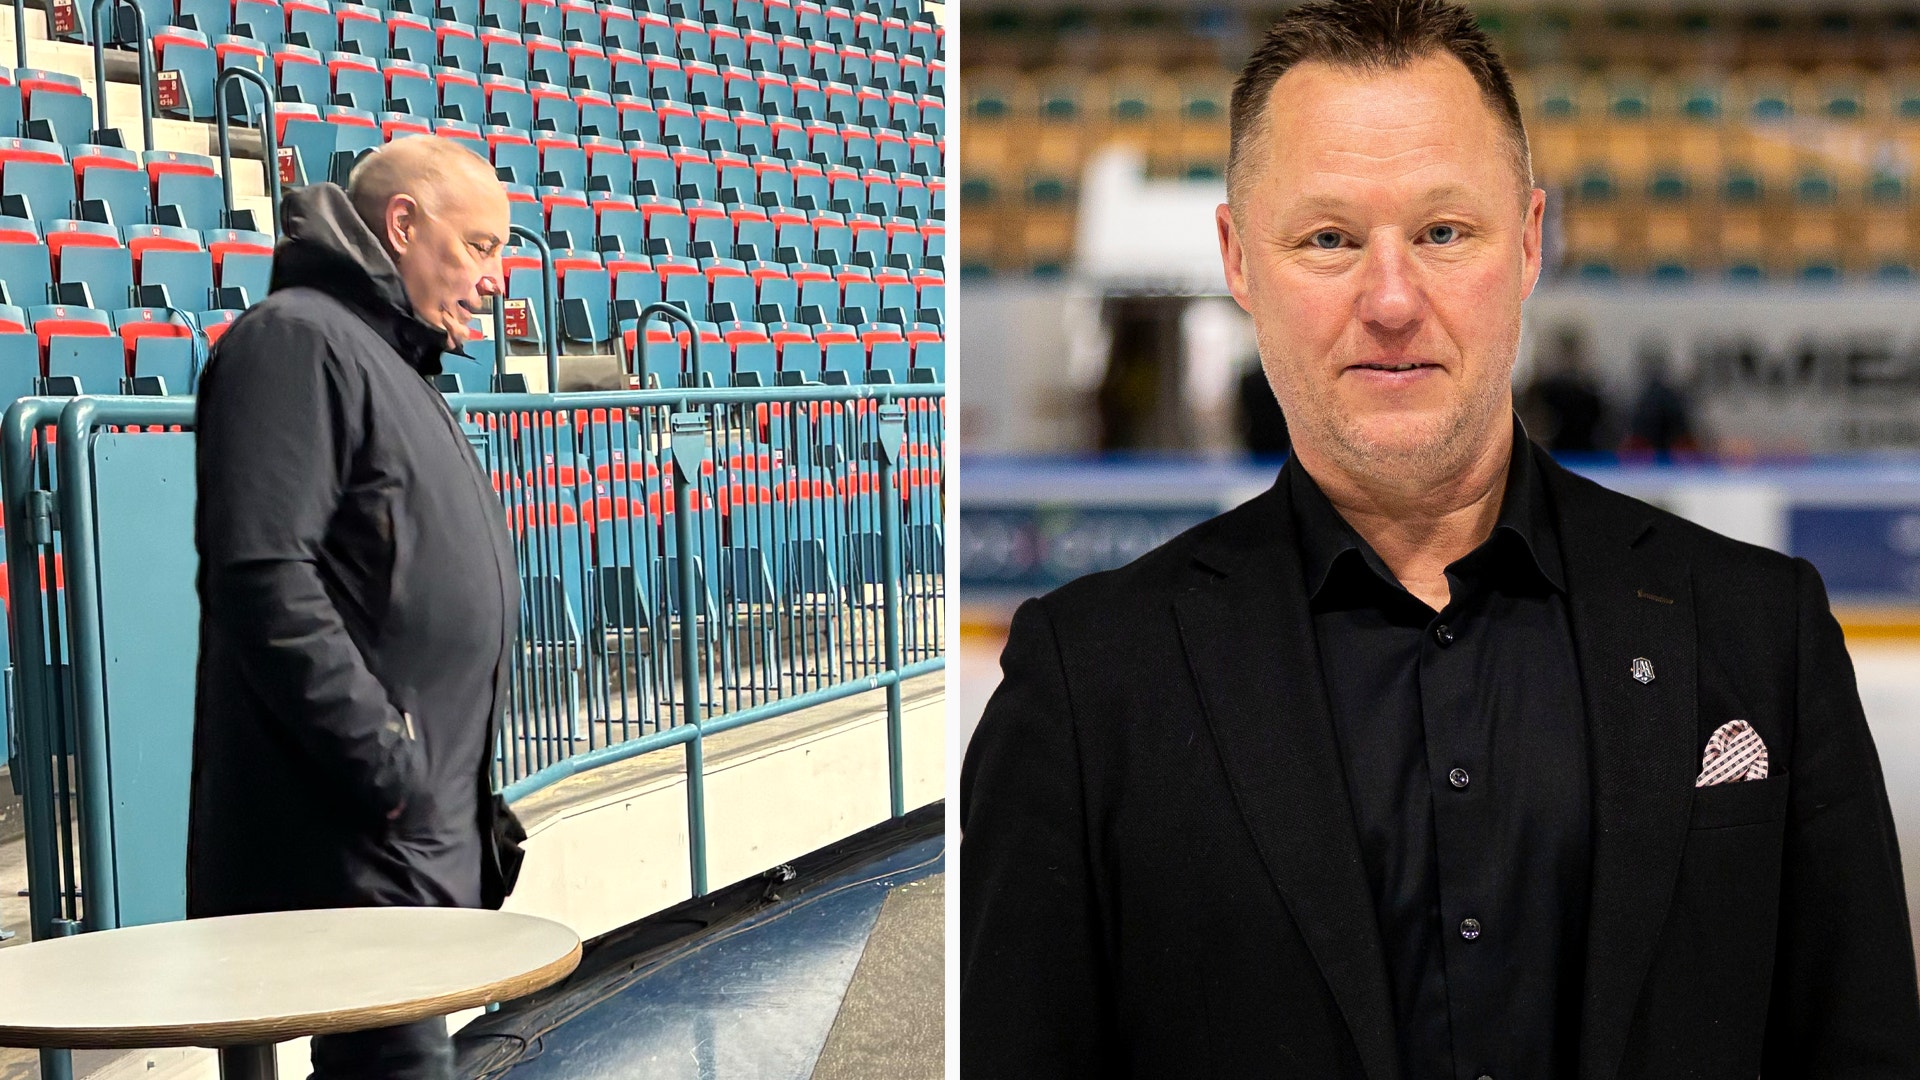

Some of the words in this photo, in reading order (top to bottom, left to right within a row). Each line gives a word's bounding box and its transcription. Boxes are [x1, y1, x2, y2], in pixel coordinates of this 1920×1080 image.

[66, 6, 71, 16] 9
[286, 156, 292, 167] 7
[520, 309, 526, 319] 5
